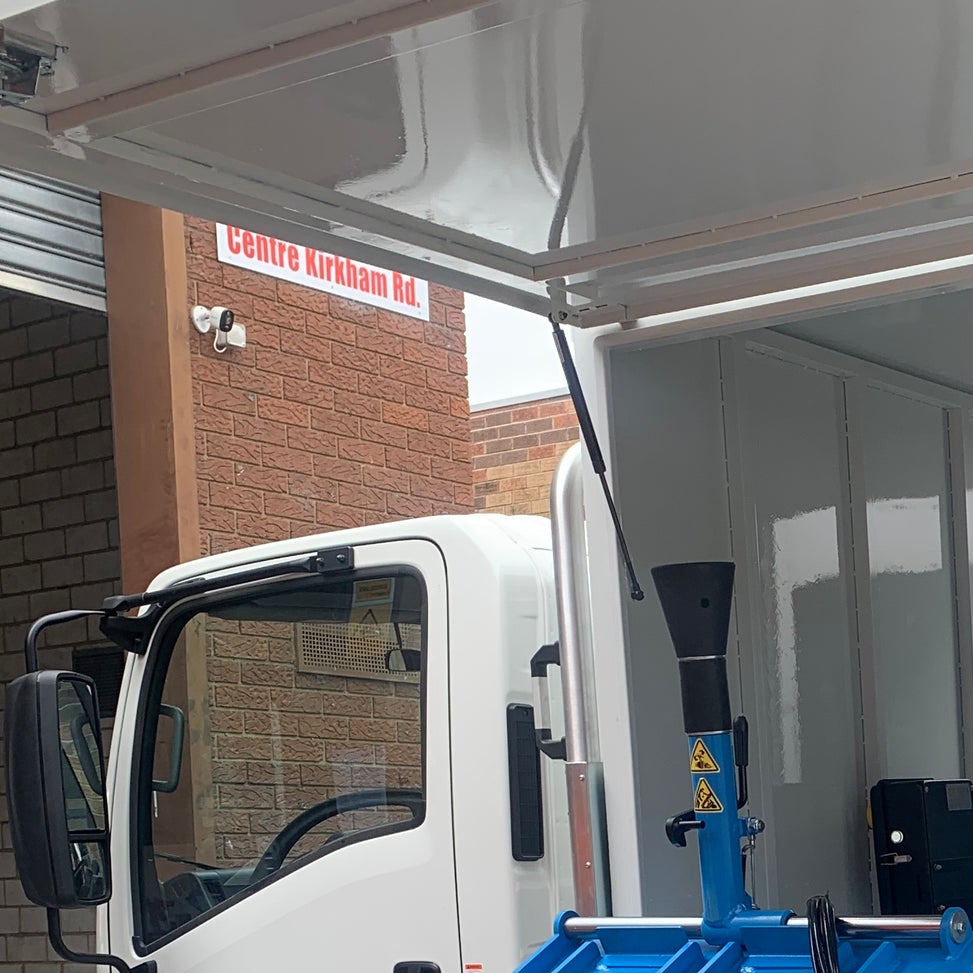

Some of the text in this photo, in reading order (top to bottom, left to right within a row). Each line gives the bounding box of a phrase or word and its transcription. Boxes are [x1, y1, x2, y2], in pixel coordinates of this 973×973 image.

[226, 225, 421, 308] Centre Kirkham Rd.
